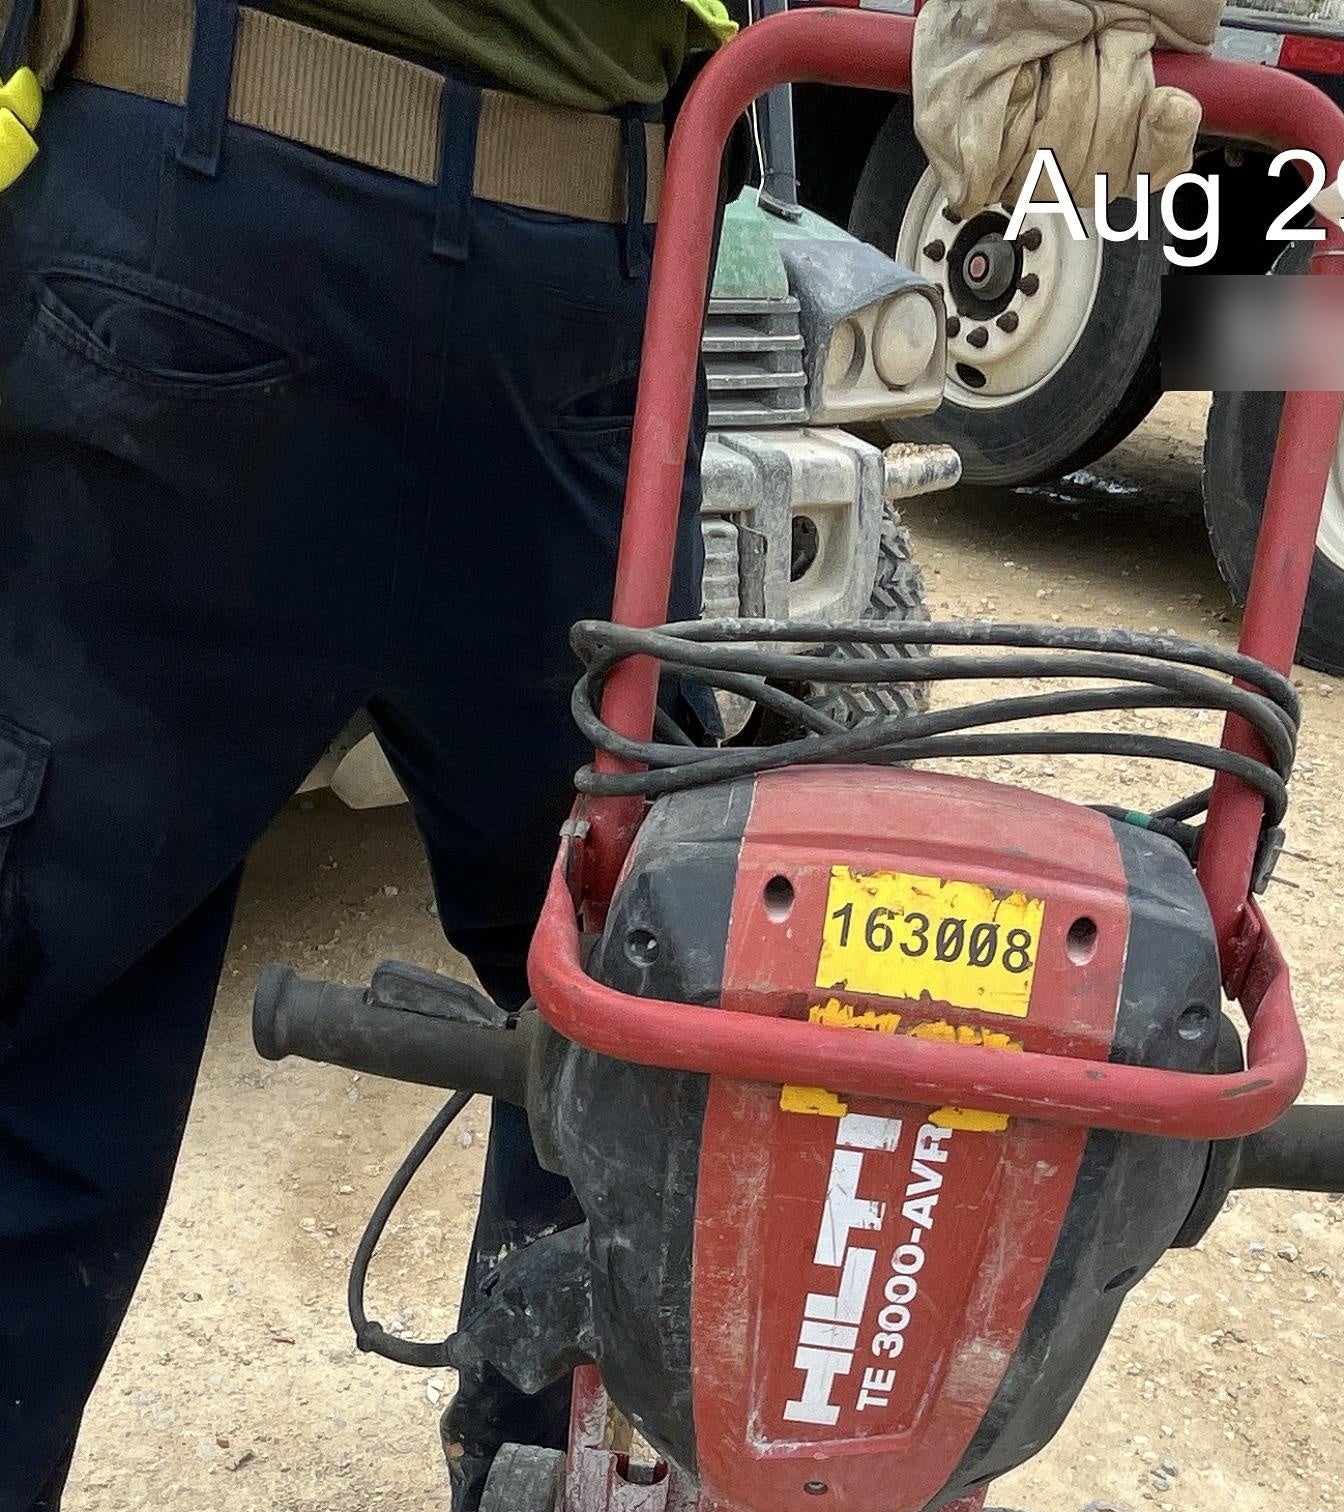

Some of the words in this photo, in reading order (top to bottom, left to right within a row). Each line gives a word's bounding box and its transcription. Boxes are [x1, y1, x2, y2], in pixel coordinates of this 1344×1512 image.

[832, 902, 1032, 974] 163008
[784, 1113, 902, 1425] HILTI
[872, 1123, 953, 1361] 3000-AVR
[857, 1366, 894, 1412] TE
